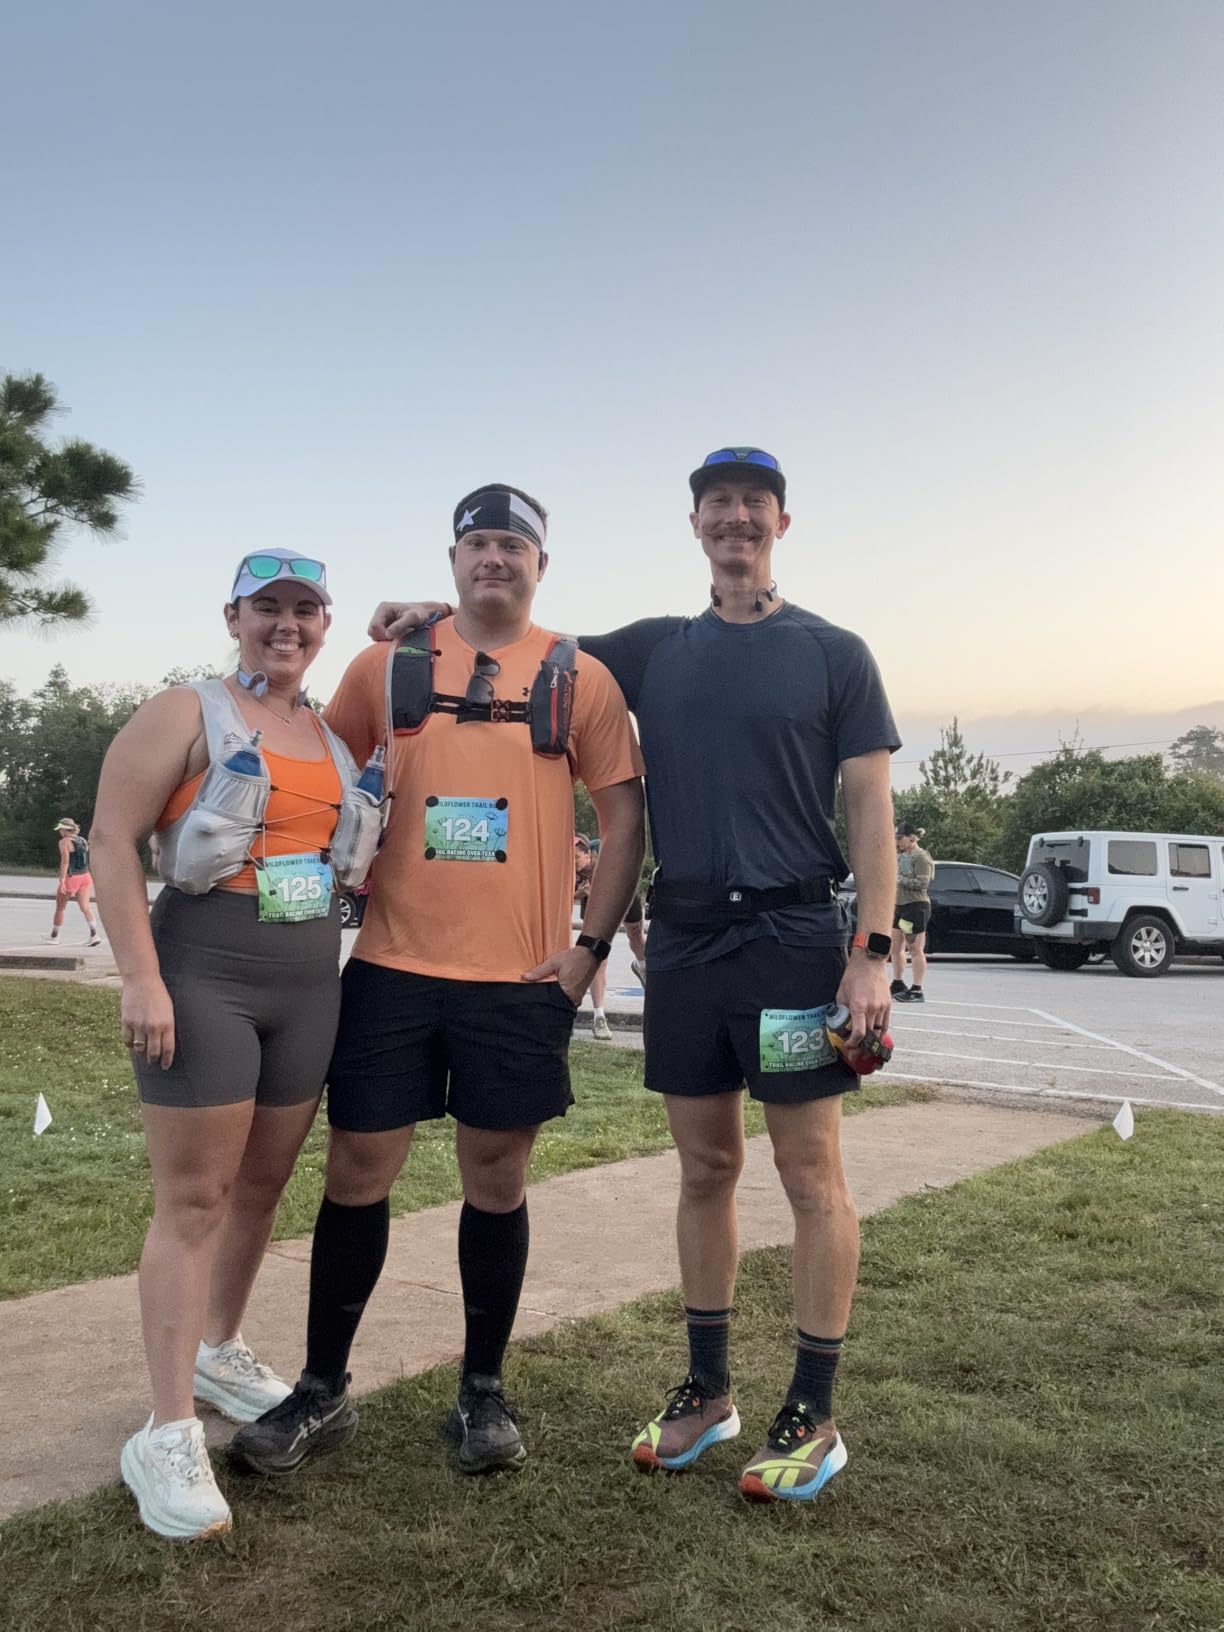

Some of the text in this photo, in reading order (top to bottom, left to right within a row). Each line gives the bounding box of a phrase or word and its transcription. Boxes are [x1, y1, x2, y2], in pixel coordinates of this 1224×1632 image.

[472, 801, 487, 809] TRAIL
[442, 818, 489, 842] 124
[277, 875, 321, 902] 125
[768, 1013, 805, 1021] WILDFLOWER
[778, 1028, 825, 1053] 123
